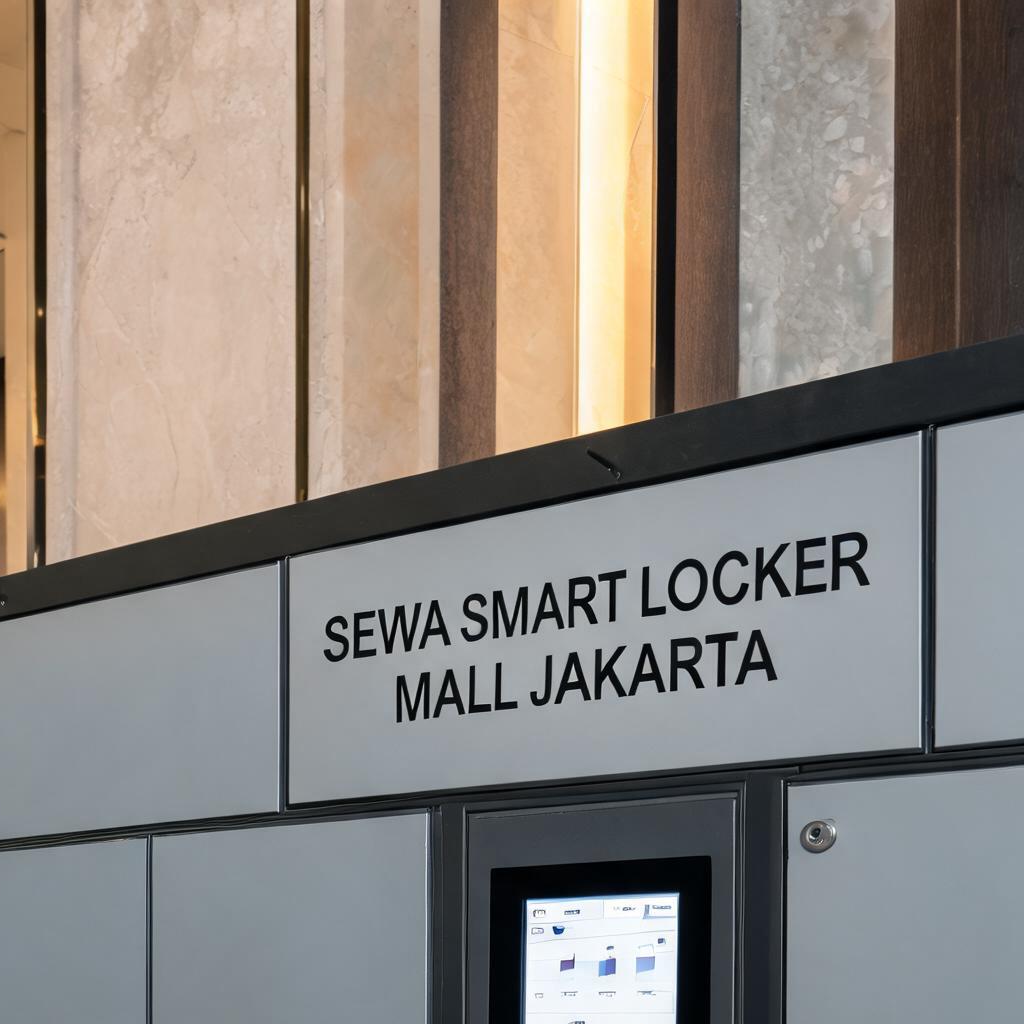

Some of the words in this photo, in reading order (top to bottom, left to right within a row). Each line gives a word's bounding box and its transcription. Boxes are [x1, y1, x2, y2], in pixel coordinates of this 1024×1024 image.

[323, 600, 452, 663] SEWA
[460, 569, 627, 643] SMART
[641, 531, 871, 618] LOCKER
[395, 662, 519, 724] MALL
[529, 629, 778, 708] JAKARTA
